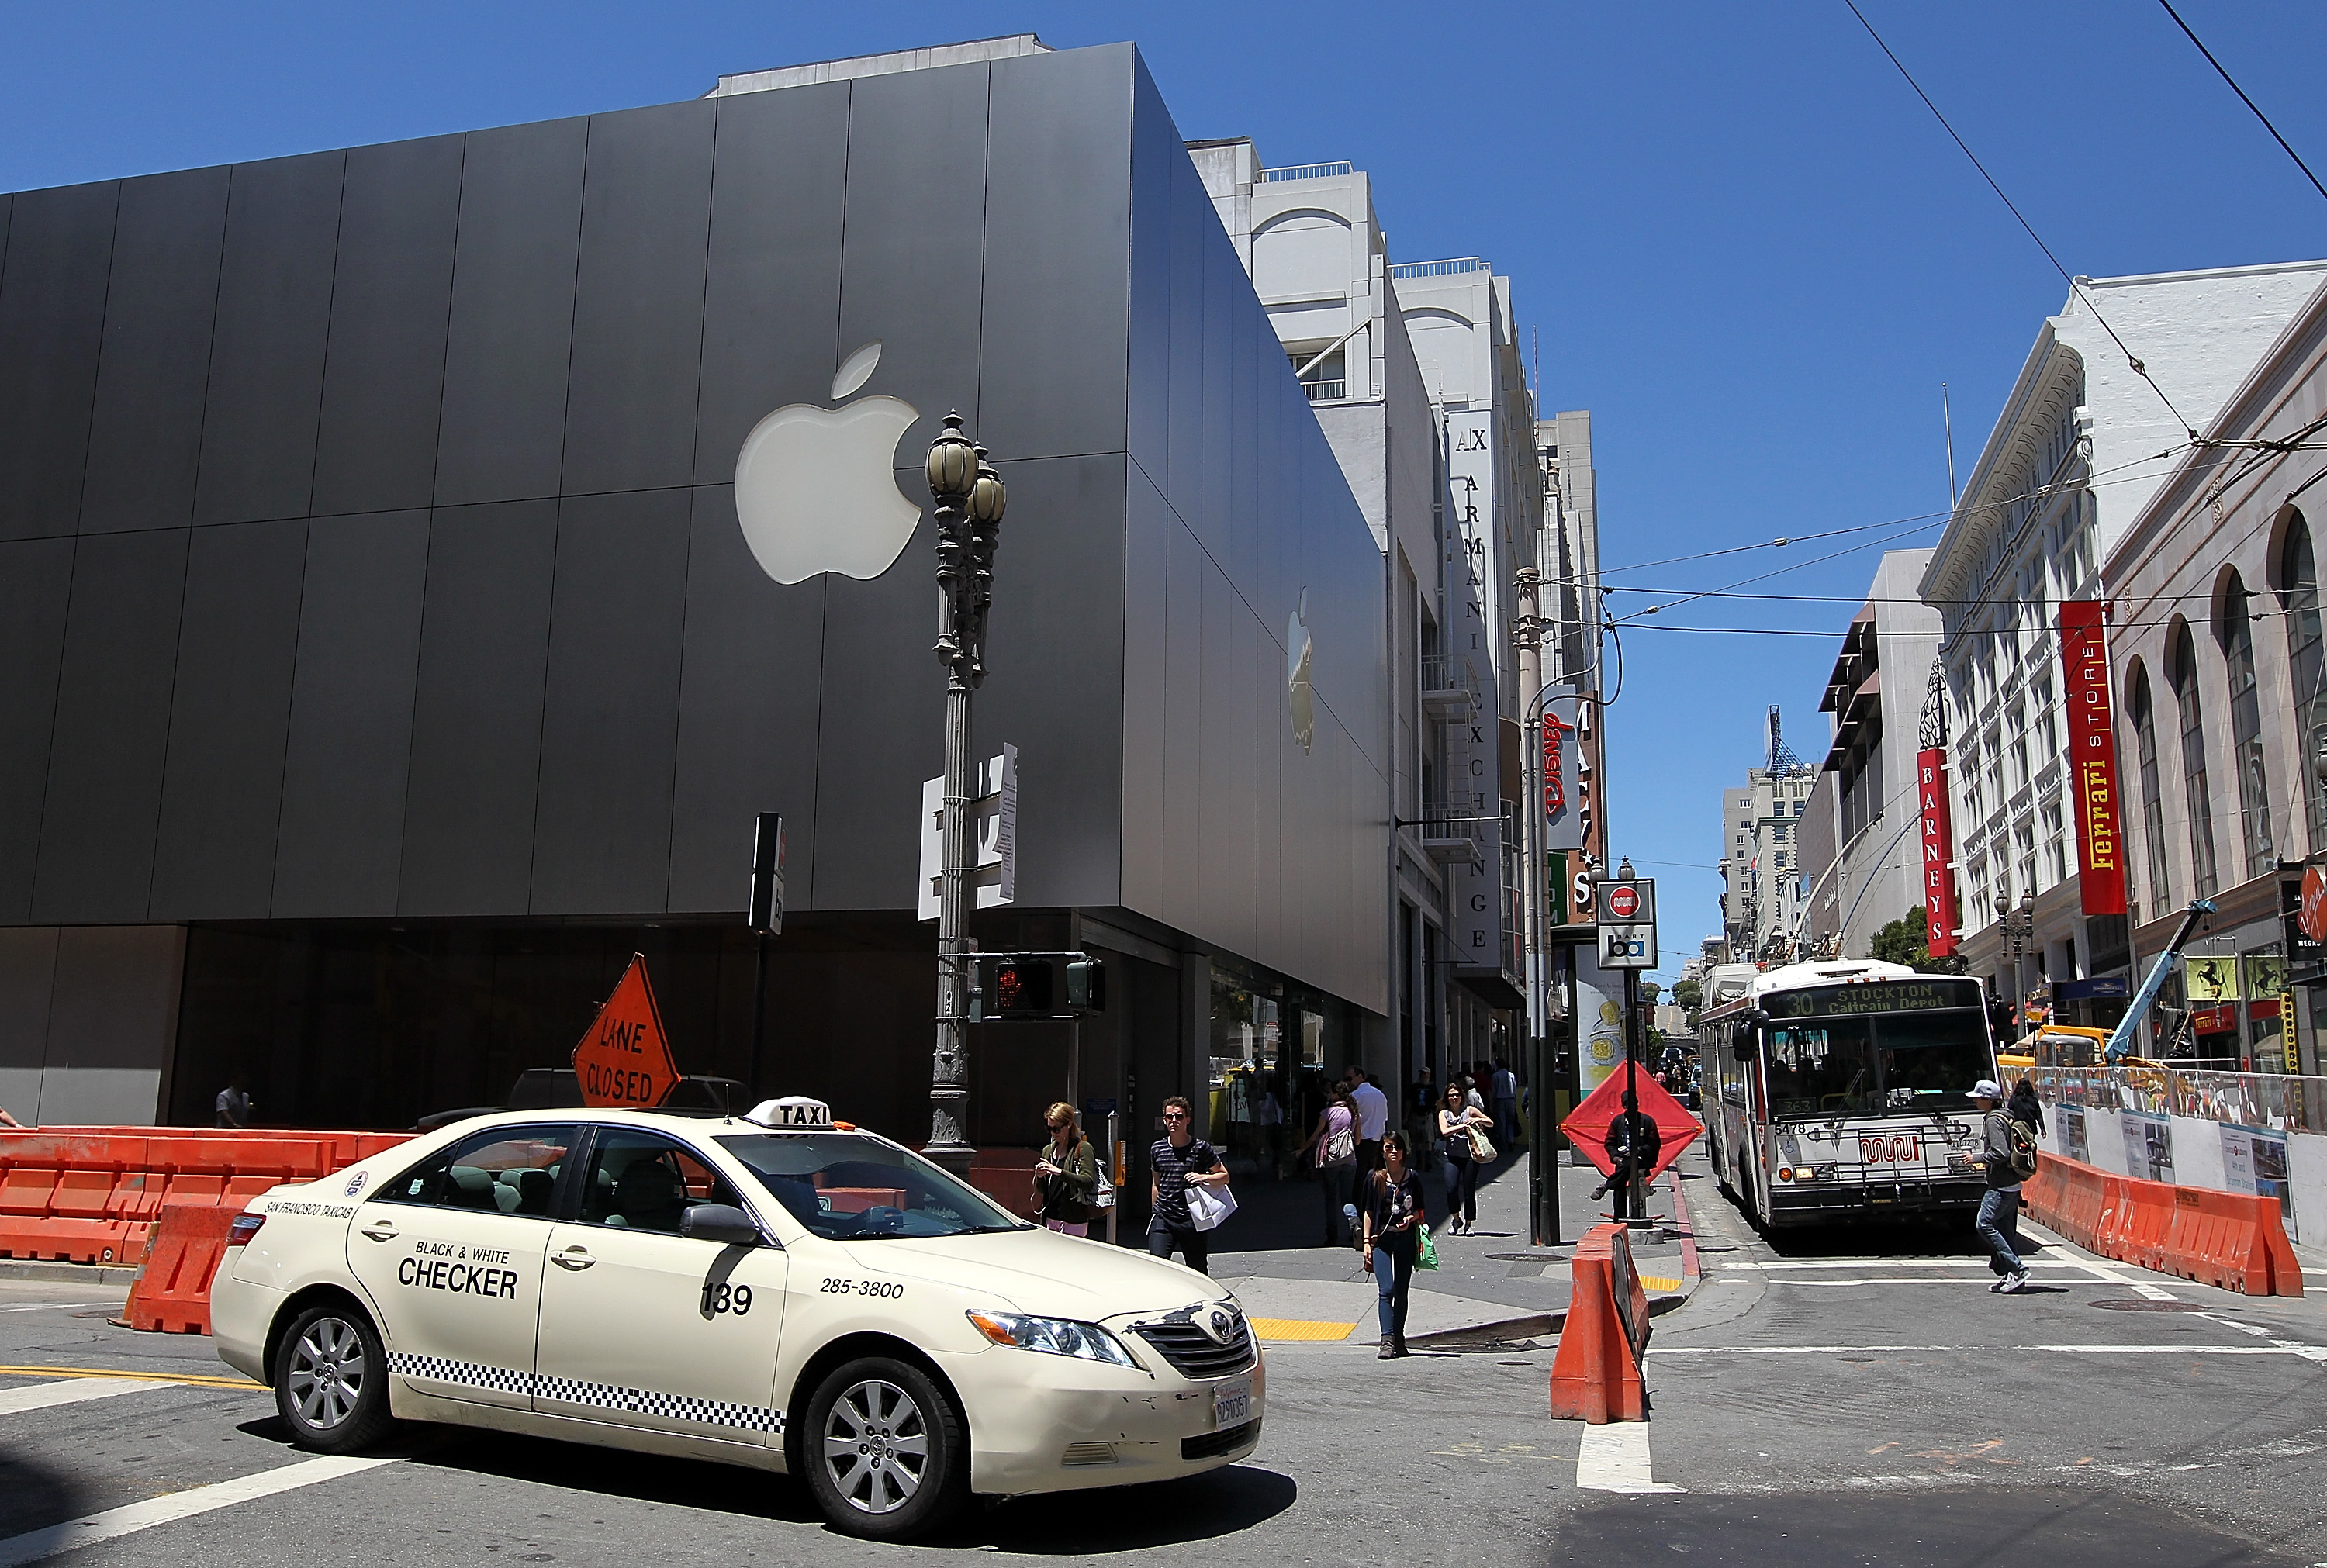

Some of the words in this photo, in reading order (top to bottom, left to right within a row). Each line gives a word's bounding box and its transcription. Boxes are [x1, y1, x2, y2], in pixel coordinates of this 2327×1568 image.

[1464, 474, 1482, 650] ARMANI
[2083, 760, 2114, 871] Ferrari
[1922, 767, 1941, 940] BARNEYS
[1786, 993, 1814, 1016] 30
[1829, 1000, 1891, 1014] Caltrain
[1900, 996, 1945, 1009] Depot
[1838, 985, 1933, 1003] STOCKTON
[600, 1016, 647, 1054] LANE
[587, 1063, 652, 1103] CLOSED
[780, 1105, 827, 1124] TAXI
[1784, 1101, 1810, 1113] 363
[1775, 1123, 1806, 1135] 5478
[265, 1202, 280, 1213] SAN
[279, 1203, 322, 1216] FRANCISCO
[320, 1205, 354, 1219] TAXICAB
[416, 1241, 455, 1258] BLACK
[458, 1246, 466, 1259] &
[472, 1248, 510, 1264] WHITE
[399, 1257, 518, 1300] CHECKER
[820, 1278, 904, 1299] 285-3800
[702, 1282, 752, 1316] 139
